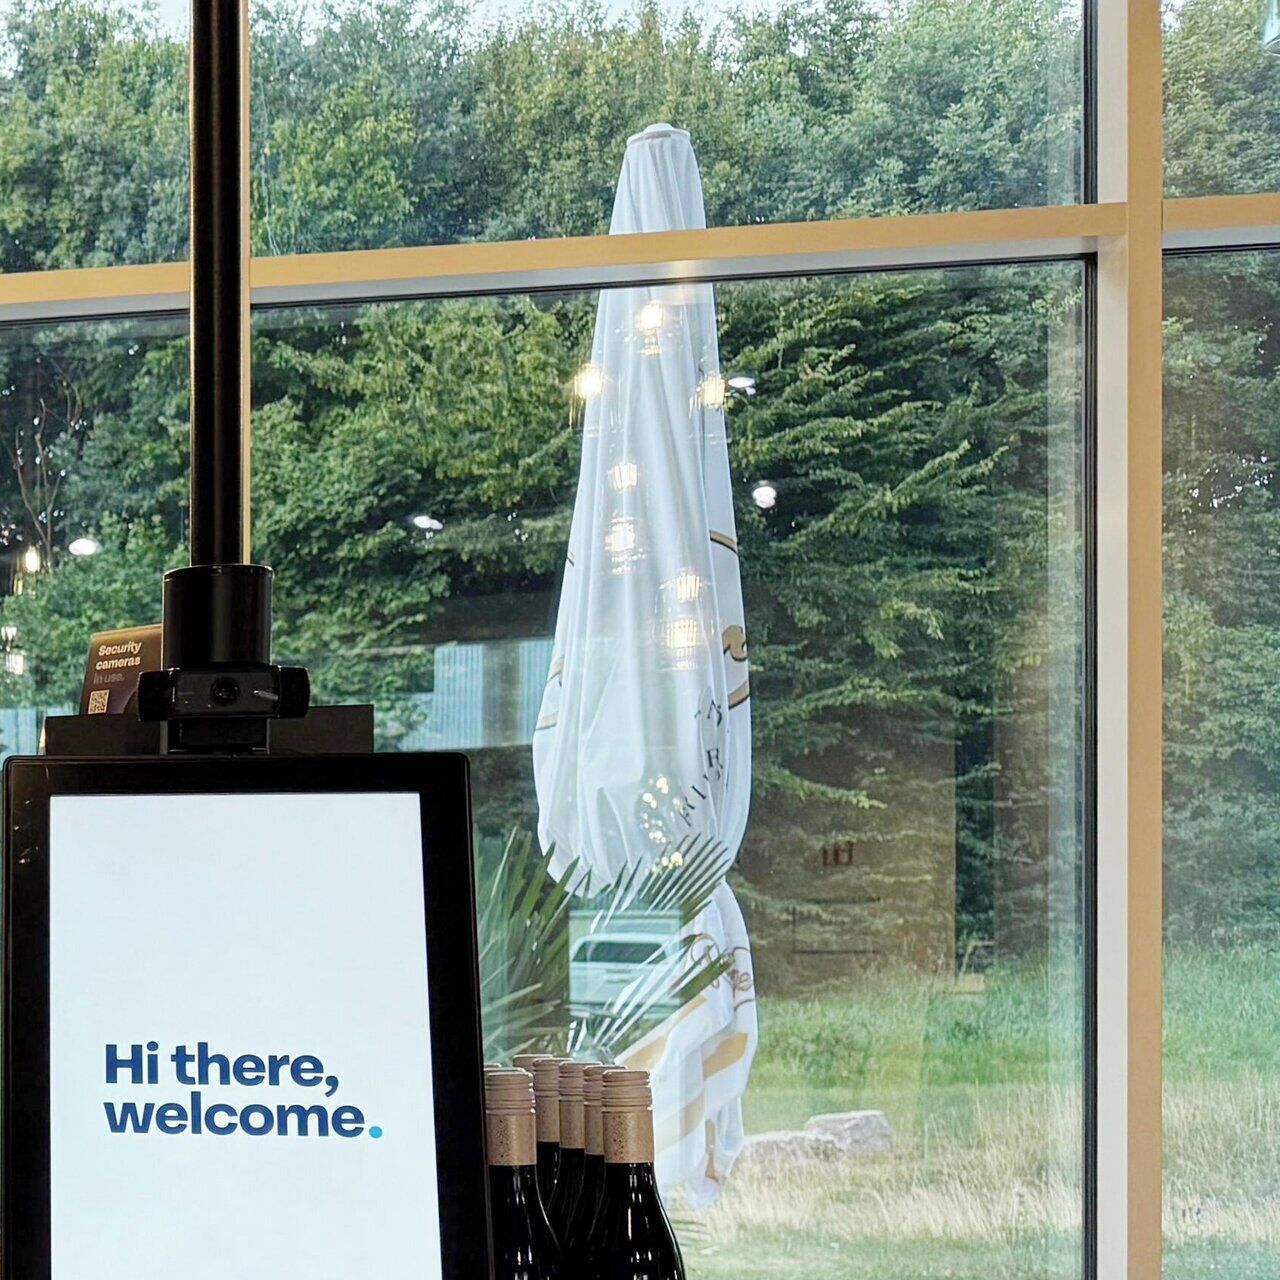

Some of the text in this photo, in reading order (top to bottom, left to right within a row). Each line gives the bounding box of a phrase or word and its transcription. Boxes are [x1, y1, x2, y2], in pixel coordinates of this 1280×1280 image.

[98, 641, 142, 657] Security
[95, 656, 141, 671] cameras
[93, 673, 125, 685] in use.
[105, 1040, 339, 1098] Hi there,
[103, 1091, 384, 1139] welcome.
